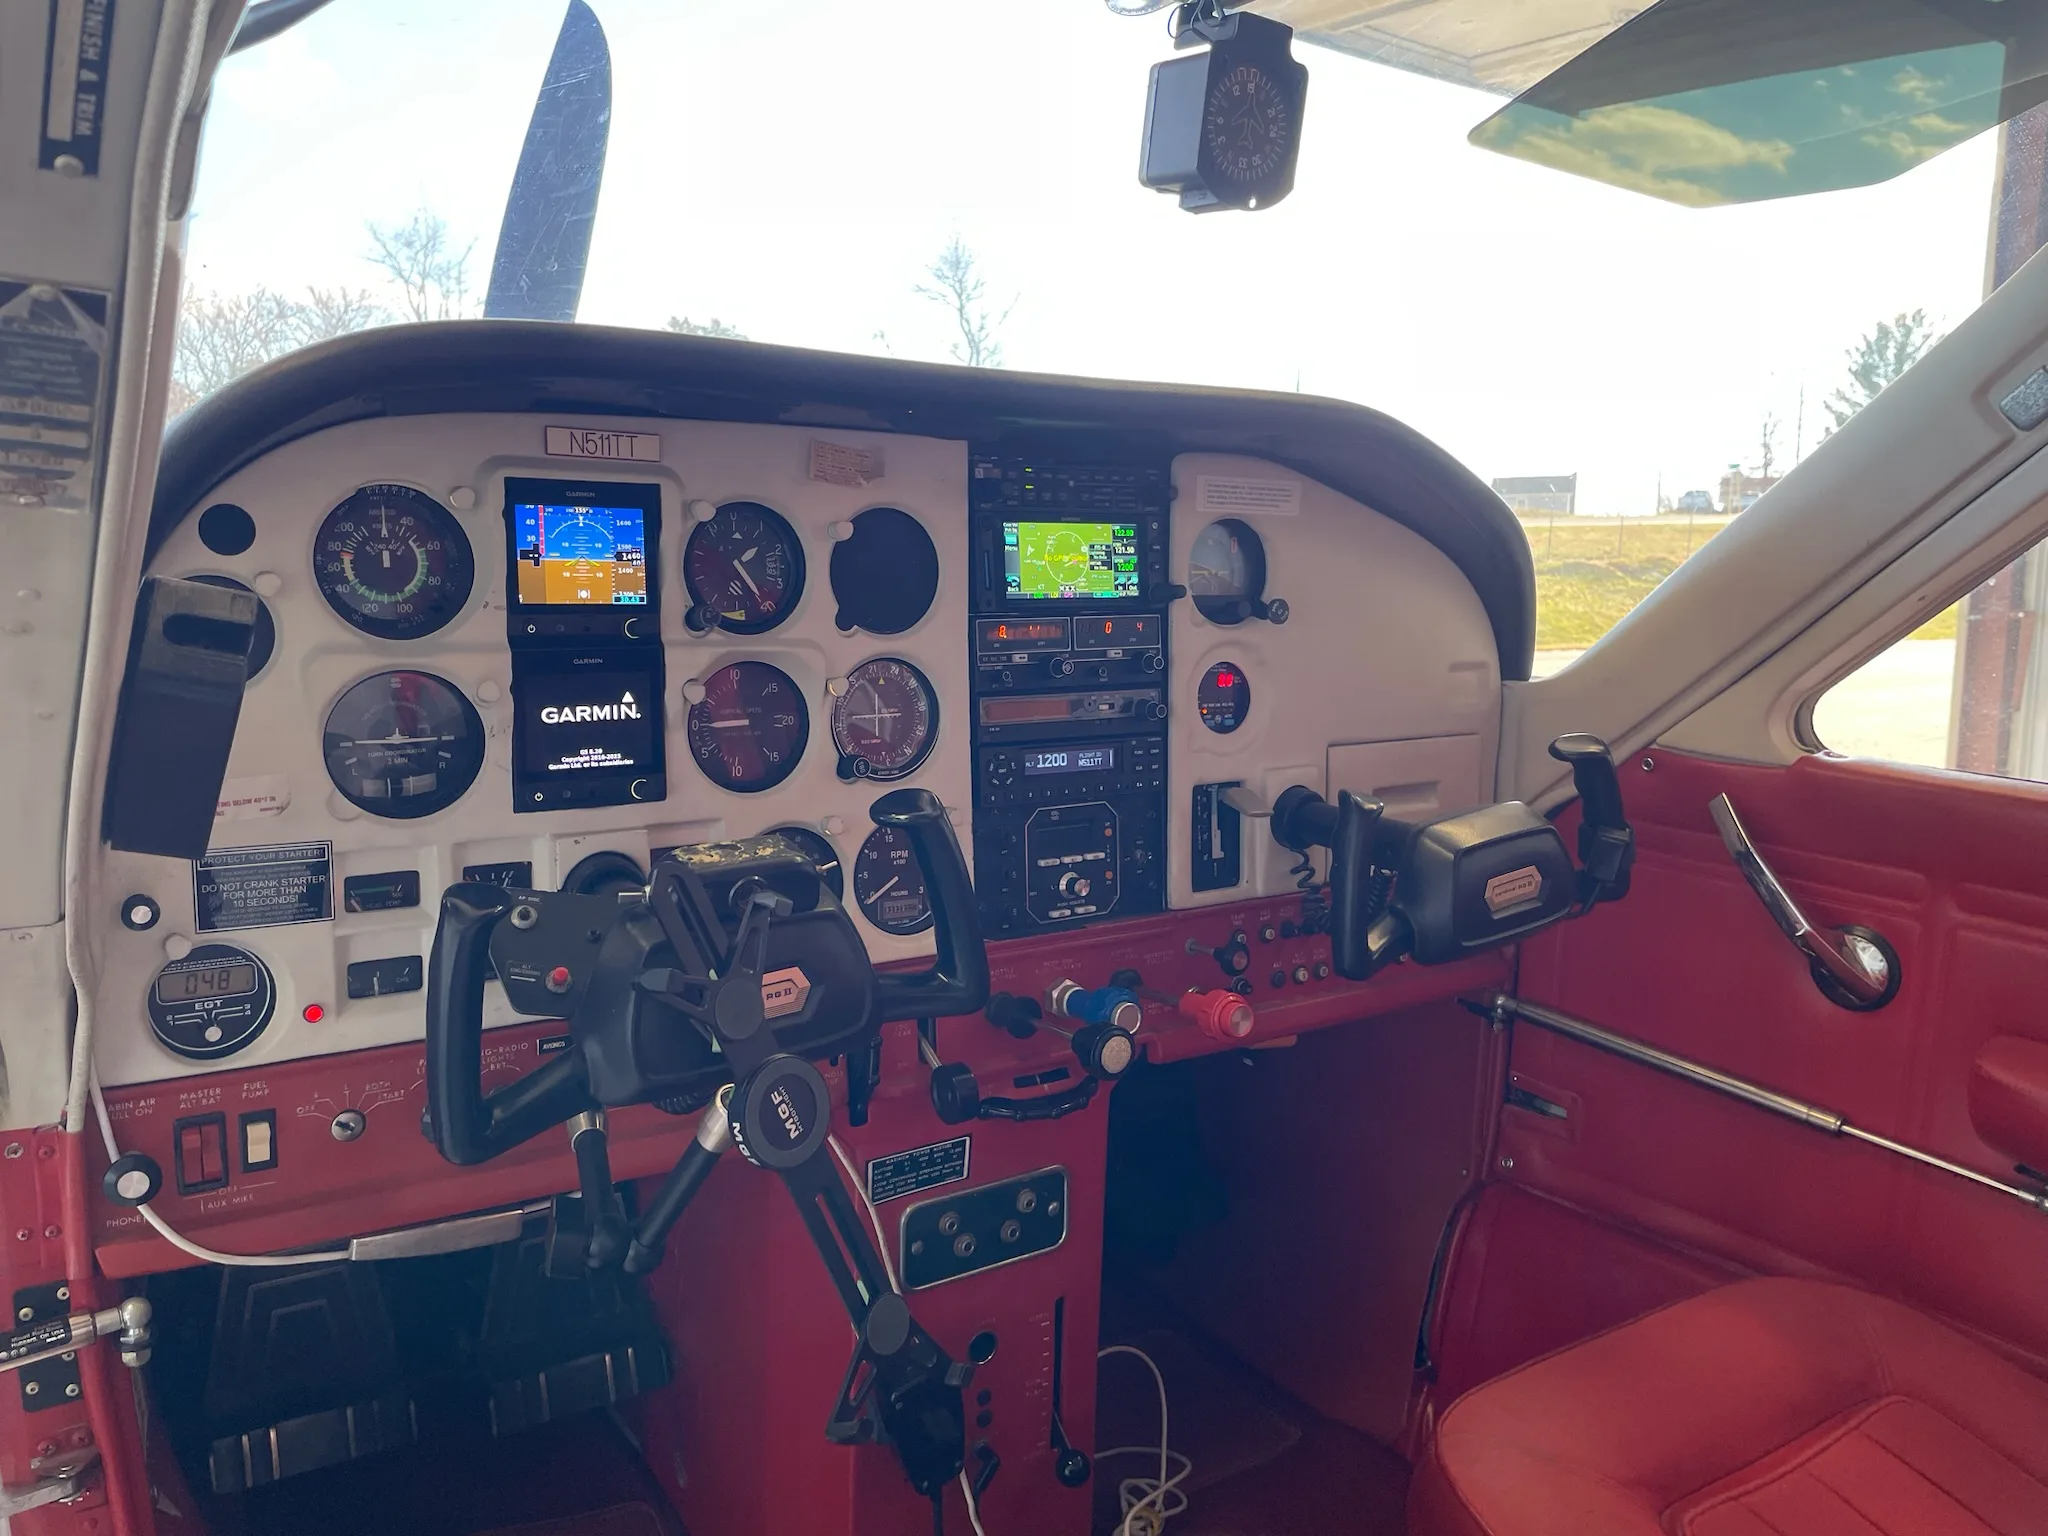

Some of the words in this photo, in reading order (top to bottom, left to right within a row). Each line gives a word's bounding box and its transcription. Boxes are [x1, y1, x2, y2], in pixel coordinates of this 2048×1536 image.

[570, 431, 638, 458] N511TT
[400, 516, 413, 526] 40
[427, 541, 440, 550] 60
[775, 544, 782, 555] 2
[1115, 546, 1135, 554] 121.50
[1117, 563, 1134, 571] 1200
[428, 576, 441, 585] 80
[777, 578, 784, 589] 3
[362, 603, 379, 613] 120
[396, 604, 413, 613] 100
[1105, 621, 1112, 634] 0
[868, 665, 877, 673] 21
[890, 666, 899, 675] 24
[729, 669, 740, 680] 10
[768, 683, 778, 693] 15
[907, 677, 919, 689] W
[917, 701, 926, 712] 30
[541, 703, 636, 724] GARMIN
[691, 720, 699, 730] 0
[782, 715, 794, 725] 20
[916, 725, 925, 736] 33
[385, 748, 427, 756] COORDINATOR
[701, 748, 709, 758] 5
[903, 745, 913, 756] N
[561, 755, 590, 763] Copyright
[770, 752, 780, 761] 15
[1036, 753, 1067, 768] 1200
[600, 759, 634, 767] subsidiaries
[1078, 758, 1102, 767] N511TT
[352, 768, 358, 776] L
[732, 766, 743, 776] 10
[201, 854, 246, 865] PROTECT
[249, 850, 276, 861] YOUR
[869, 851, 877, 859] 10
[890, 850, 908, 858] RPM
[201, 885, 217, 893] DO
[220, 882, 241, 891] NOT
[243, 880, 279, 890] CRANK
[281, 875, 326, 886] STARTER
[223, 891, 245, 900] FOR
[247, 888, 277, 898] MORE
[280, 885, 307, 893] THAN
[246, 895, 299, 907] SECONDS!
[185, 970, 230, 994] 048
[194, 1000, 223, 1010] EGT
[542, 1040, 566, 1050] AVIONICS
[482, 1054, 515, 1064] LIGHTS
[490, 1062, 507, 1070] BRT
[243, 1081, 267, 1090] FUEL
[344, 1083, 349, 1091] L
[365, 1080, 391, 1091] BOTH
[179, 1087, 222, 1100] MASTER
[242, 1089, 270, 1099] PUMP
[108, 1101, 133, 1112] ABIN
[139, 1098, 156, 1107] AIR
[179, 1101, 197, 1109] ALT
[201, 1096, 222, 1105] BAT
[111, 1111, 129, 1120] ULL
[135, 1107, 153, 1116] ON
[296, 1105, 315, 1114] OFF
[779, 1085, 804, 1133] MYGOFLIGHT
[770, 1091, 800, 1140] MGF
[886, 1155, 910, 1164] MAXIMUM
[913, 1148, 931, 1158] POWER
[933, 1143, 953, 1152] MIXTURE
[218, 1186, 238, 1196] OFF
[207, 1199, 227, 1209] AUX
[232, 1194, 254, 1204] MIKE
[106, 1215, 142, 1227] PHONE
[51, 1328, 65, 1336] USA
